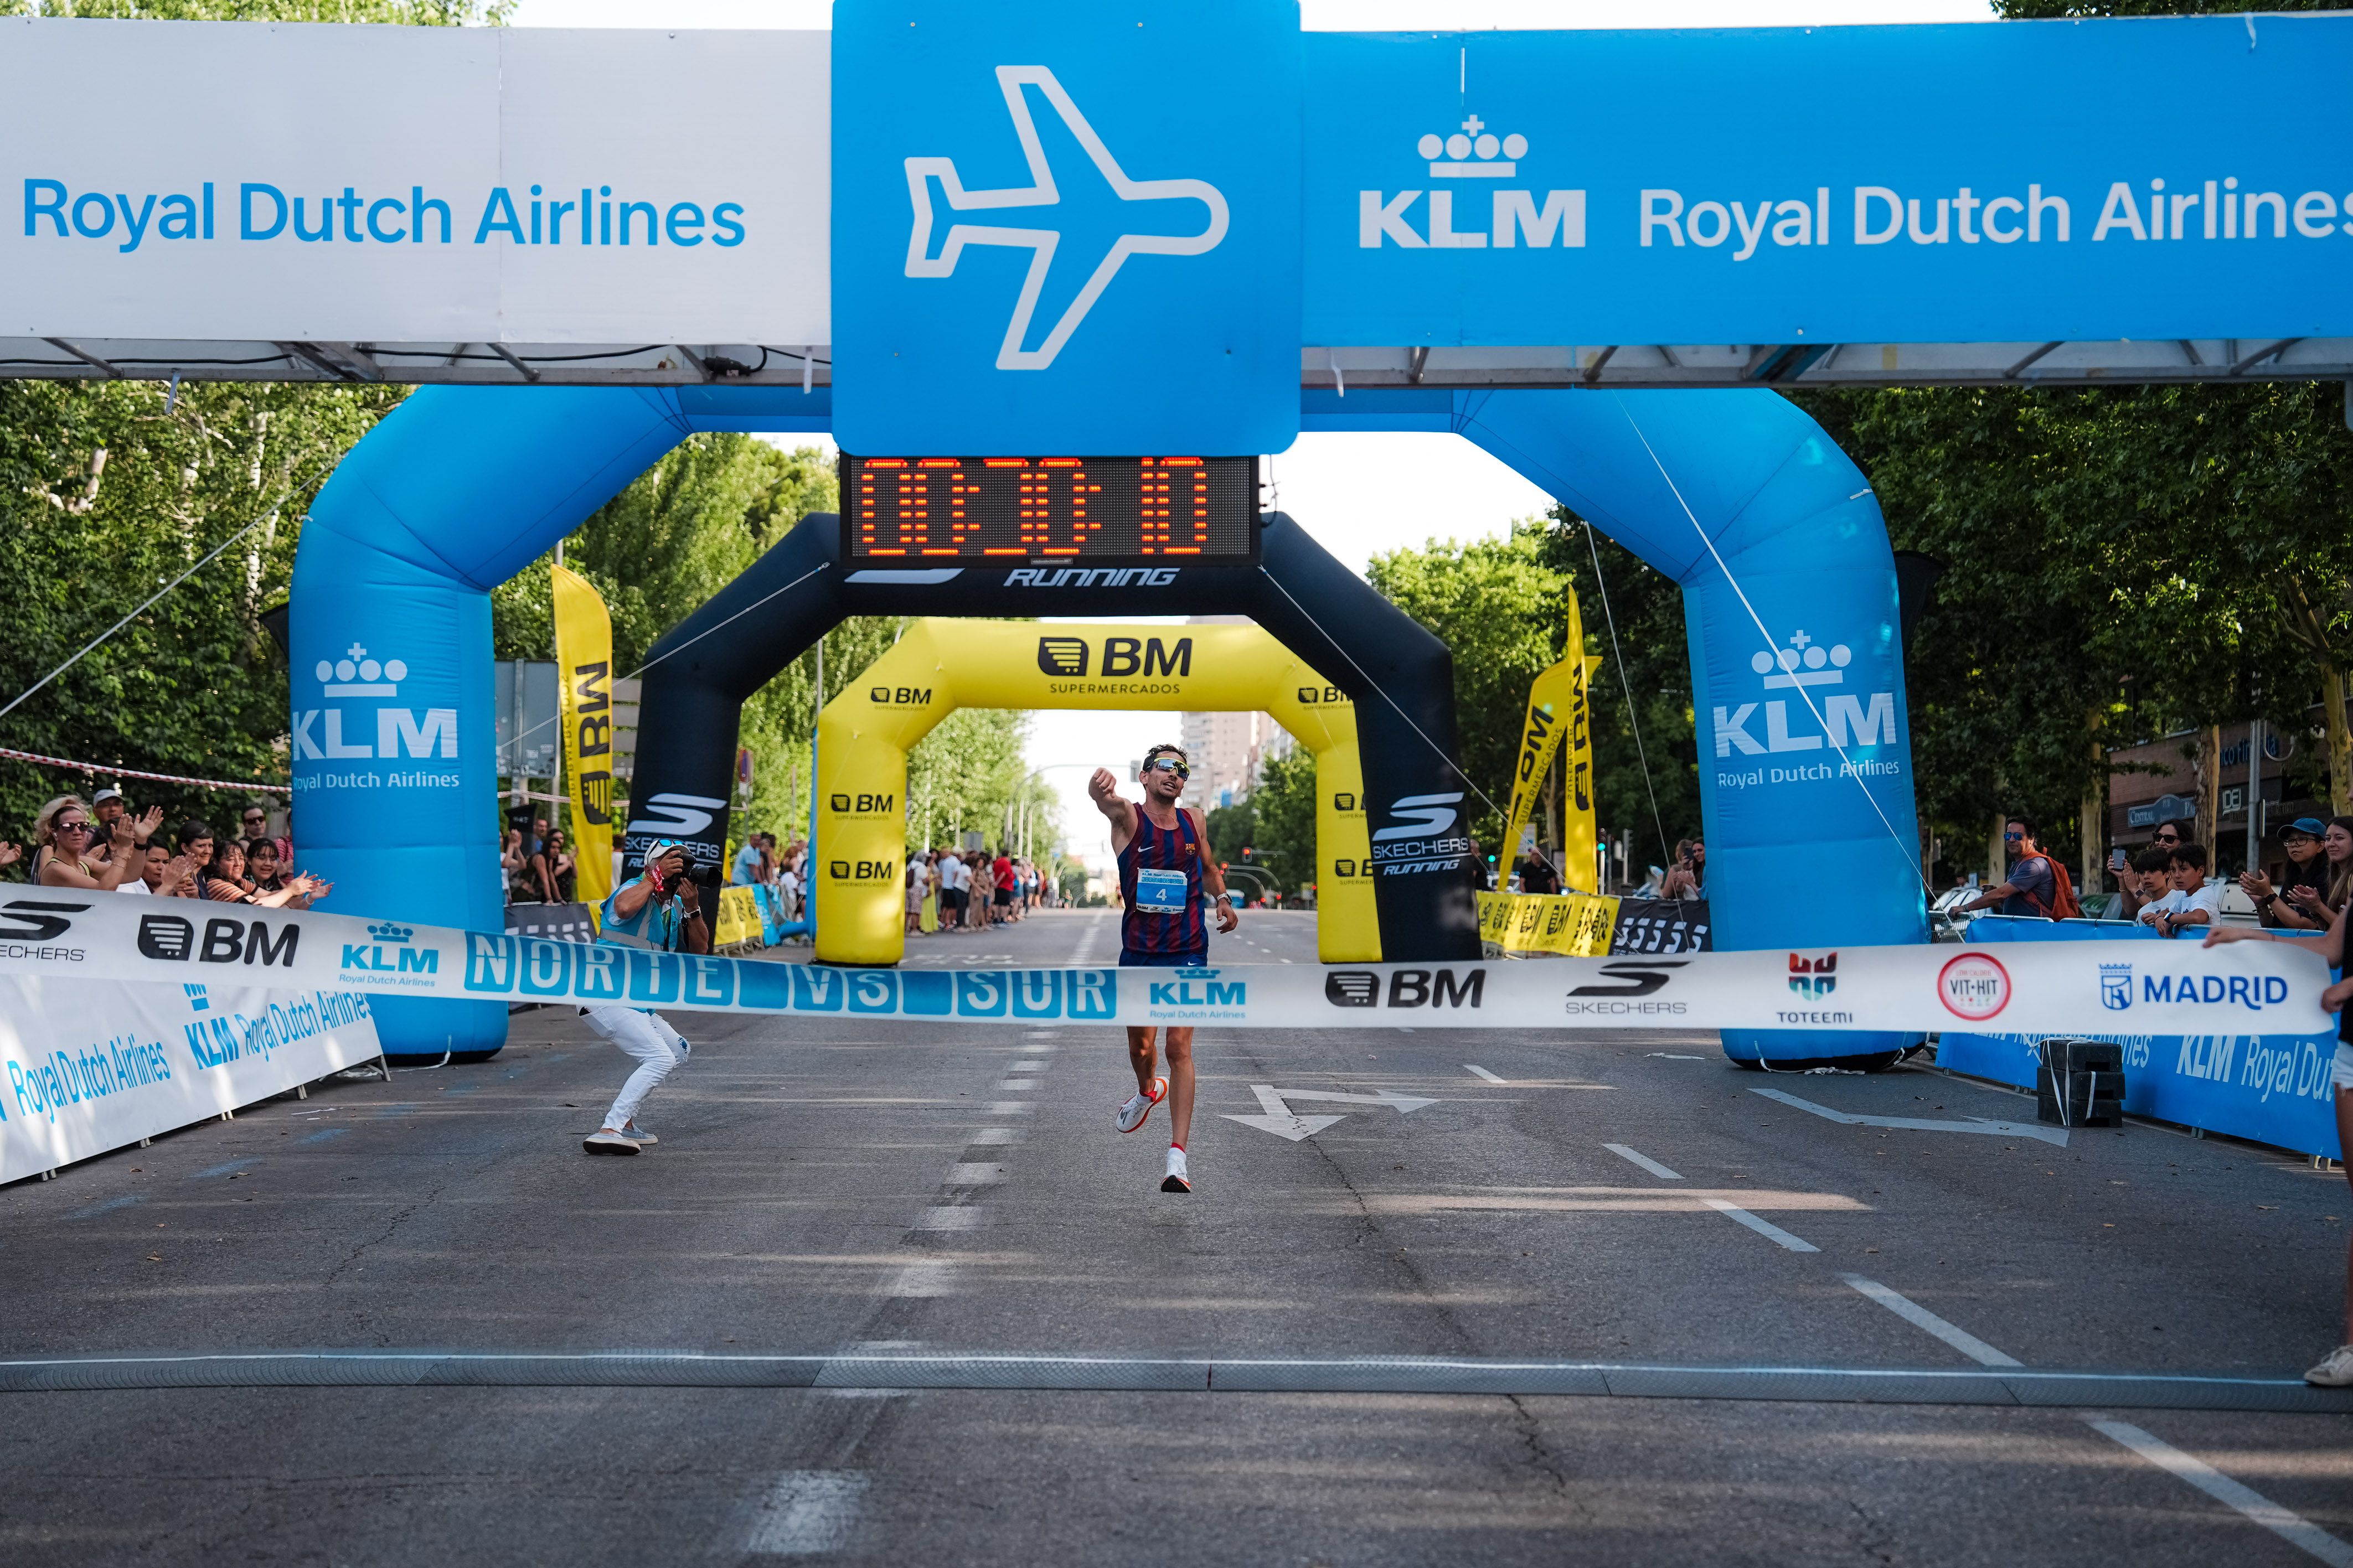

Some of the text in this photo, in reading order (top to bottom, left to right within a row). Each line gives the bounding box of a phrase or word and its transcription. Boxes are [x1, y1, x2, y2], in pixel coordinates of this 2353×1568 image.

[24, 179, 746, 253] Royal Dutch Airlines
[1359, 189, 1587, 249] KLM
[1639, 177, 2353, 261] Royal Dutch Airline
[1004, 567, 1181, 587] RUNNING
[1102, 638, 1193, 676] BM
[895, 688, 932, 704] BM
[1051, 684, 1180, 695] SUPERMERCADOS
[293, 708, 457, 761] KLM
[1714, 692, 1896, 758] KLM
[293, 772, 460, 793] Royal Dutch Airlines
[1518, 727, 1563, 825] SUPERMERCADOS
[1719, 759, 1899, 789] Royal Dutch Airlines
[856, 795, 893, 812] BM
[624, 836, 720, 858] SKEERS
[1372, 837, 1469, 859] SKECHERS
[855, 861, 892, 879] BM
[1384, 859, 1460, 876] RUNNING
[1156, 888, 1167, 901] 4
[0, 945, 85, 962] ECHERS
[199, 918, 300, 967] BM
[341, 944, 439, 974] KLM
[339, 974, 435, 988] Royal Dutch Airlines
[474, 934, 1106, 1012] NORTE VS SUR
[1150, 982, 1246, 1005] KLM
[1387, 969, 1487, 1008] BM
[2144, 975, 2288, 1010] MADRID
[1150, 1010, 1246, 1020] Royal Dutch Airlines
[1566, 1002, 1686, 1015] SKECHERS
[1777, 1012, 1853, 1024] TOTEEMI
[184, 1017, 239, 1070] KLM
[235, 1013, 278, 1062] Royal
[270, 995, 321, 1045] Dutch
[7, 1059, 66, 1124] Royal
[57, 1044, 116, 1104] Dutch
[110, 1033, 171, 1091] Airlines
[2176, 1035, 2236, 1083] KLM
[2241, 1035, 2300, 1104] Royal
[2297, 1042, 2334, 1102] Dut
